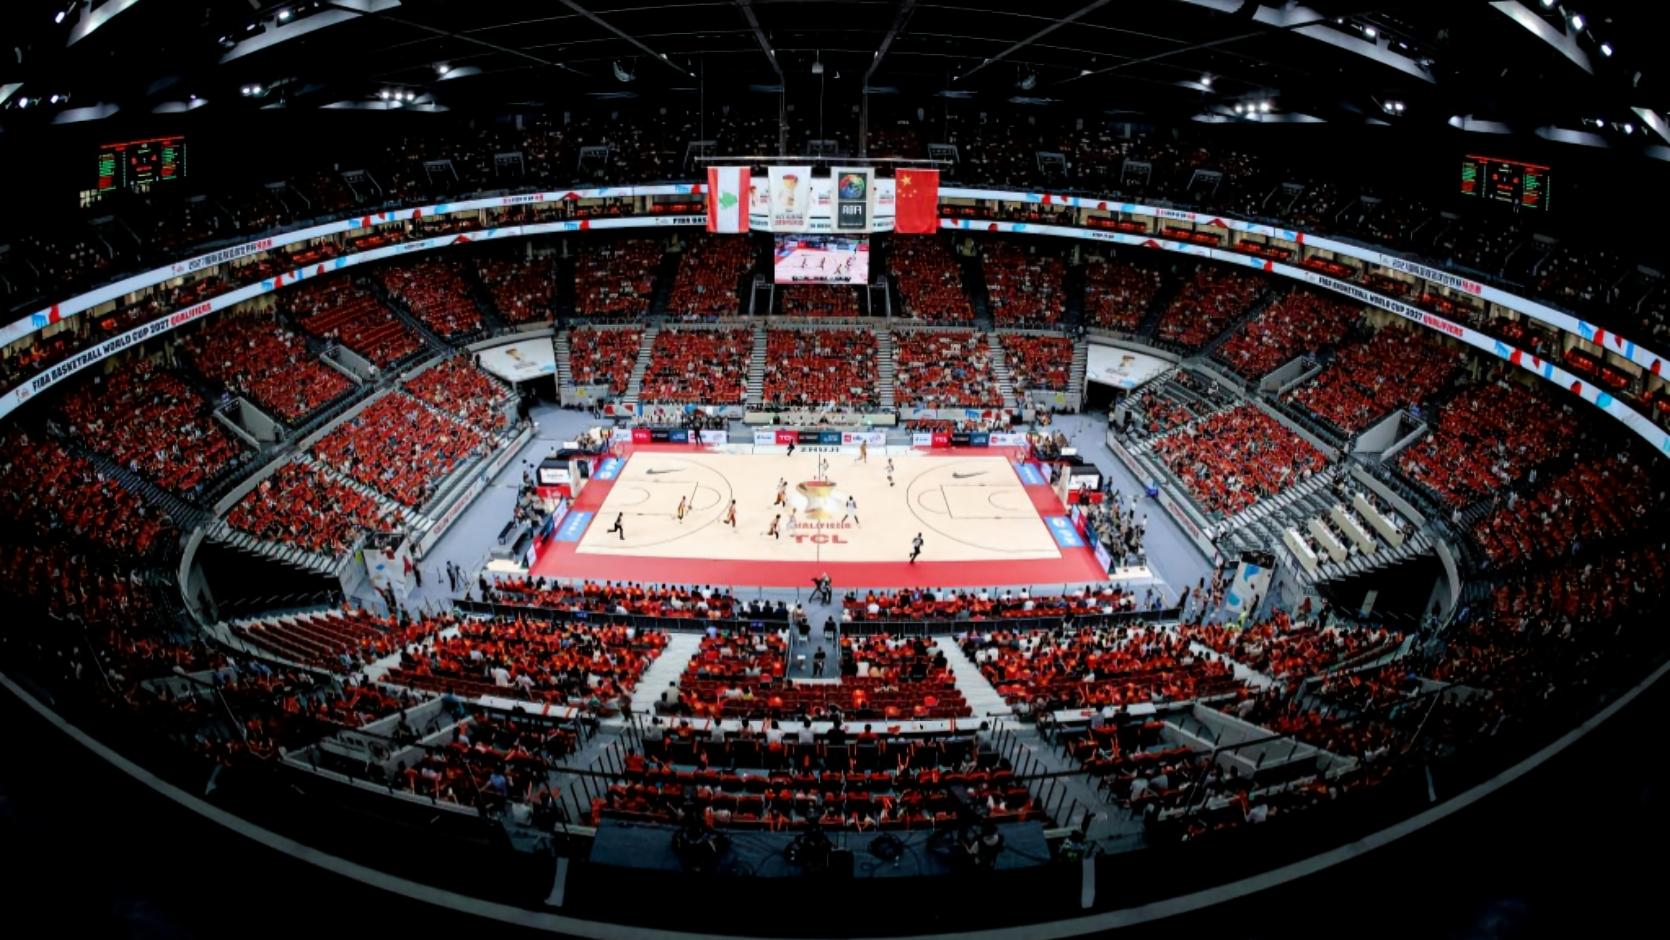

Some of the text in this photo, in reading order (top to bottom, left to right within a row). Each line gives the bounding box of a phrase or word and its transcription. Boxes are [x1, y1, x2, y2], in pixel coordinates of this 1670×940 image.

[1369, 293, 1390, 309] WORLD
[1391, 301, 1405, 314] CUP
[32, 303, 213, 392] FIBA BASKETBALL WORLD CUP 2027 QUALIFIERS
[790, 534, 848, 544] TCL
